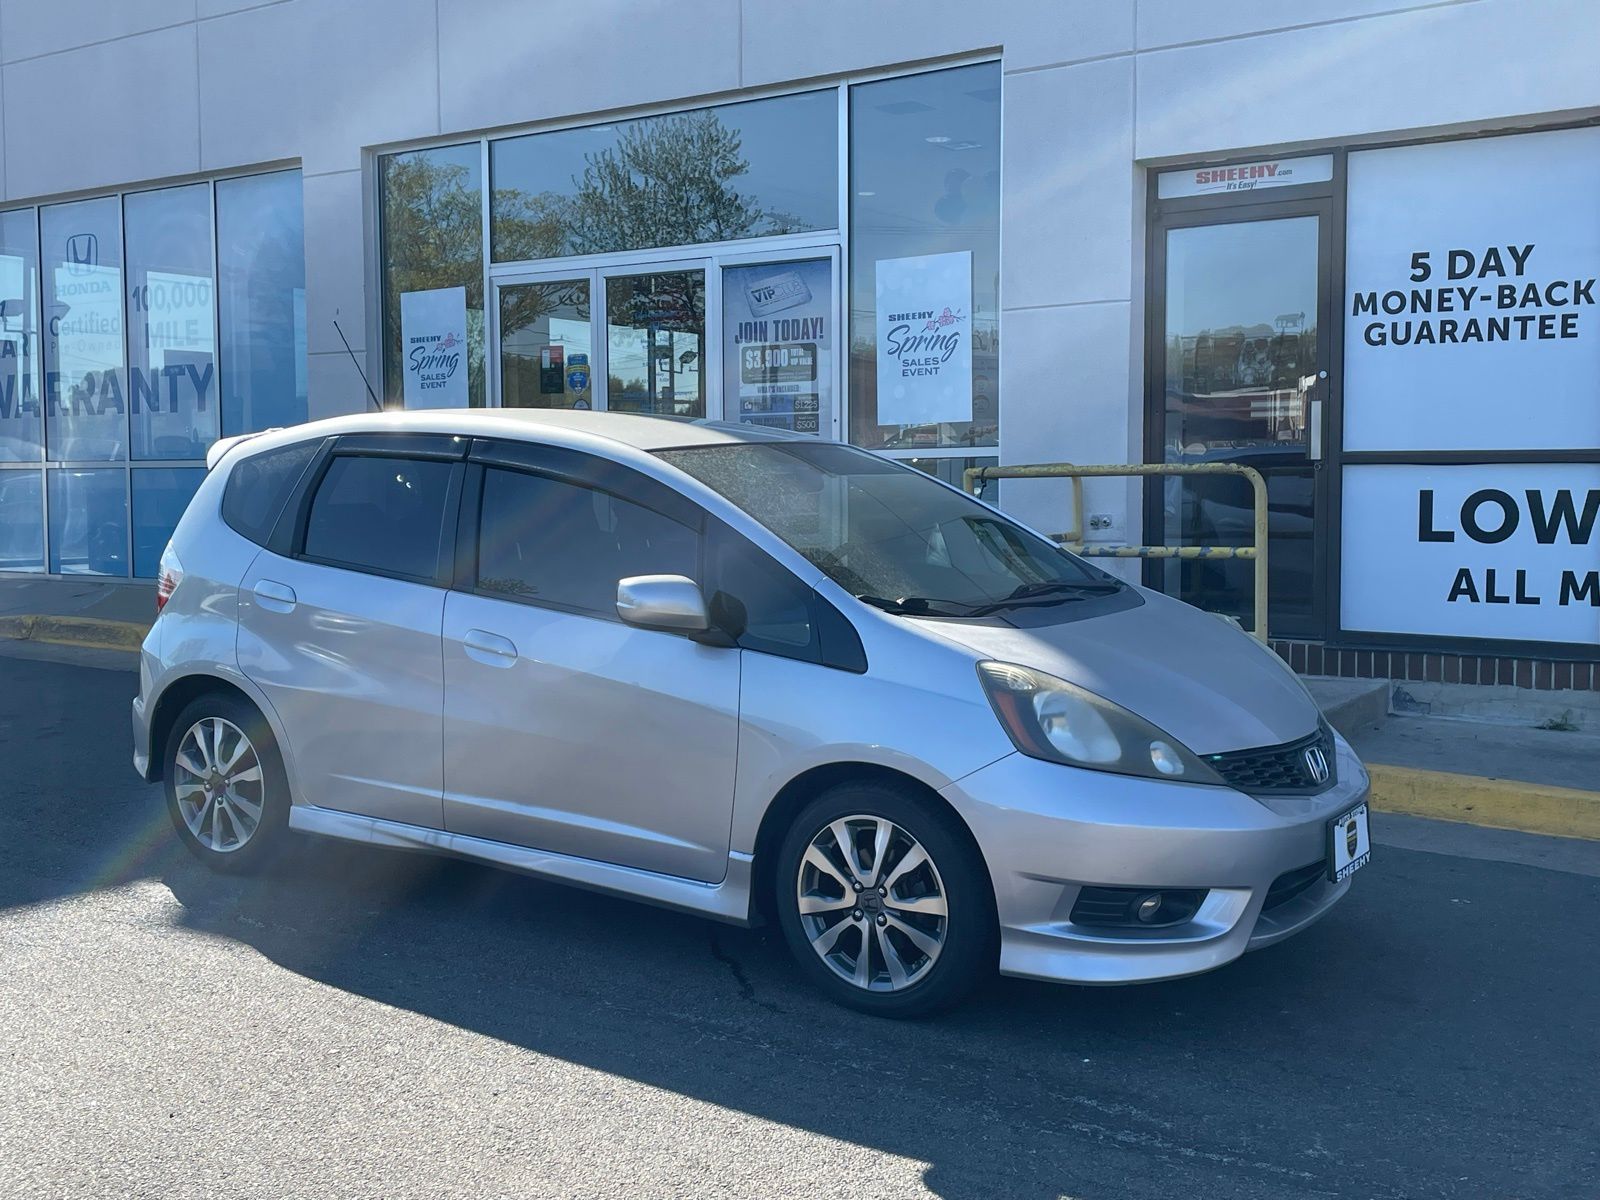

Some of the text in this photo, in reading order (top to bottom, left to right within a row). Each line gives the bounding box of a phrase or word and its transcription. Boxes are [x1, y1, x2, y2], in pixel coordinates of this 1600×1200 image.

[1196, 163, 1293, 184] SHEEHY.com
[1226, 179, 1258, 191] It's Easy!
[1409, 244, 1536, 283] 5 DAY
[54, 280, 112, 297] HONDA
[132, 280, 210, 315] 100,000
[752, 289, 776, 303] VIP
[1352, 279, 1597, 317] MONEY-BACK
[49, 309, 120, 337] Certified
[888, 311, 934, 322] SHEEHY
[145, 319, 200, 350] MILE
[410, 334, 442, 344] SHEEHY
[734, 317, 824, 344] JOIN TODAY!
[1364, 313, 1579, 347] GUARANTEE
[50, 337, 121, 354] Pe-Owned
[886, 324, 961, 363] Spring
[409, 345, 460, 378] Spring
[902, 356, 940, 368] SALES
[902, 366, 941, 377] EVENT
[420, 372, 447, 381] SALES
[420, 381, 448, 390] EVENT
[796, 420, 816, 429] $500
[1418, 488, 1600, 545] LOW
[1447, 567, 1541, 606] ALL
[1336, 851, 1372, 883] SHEEHY
